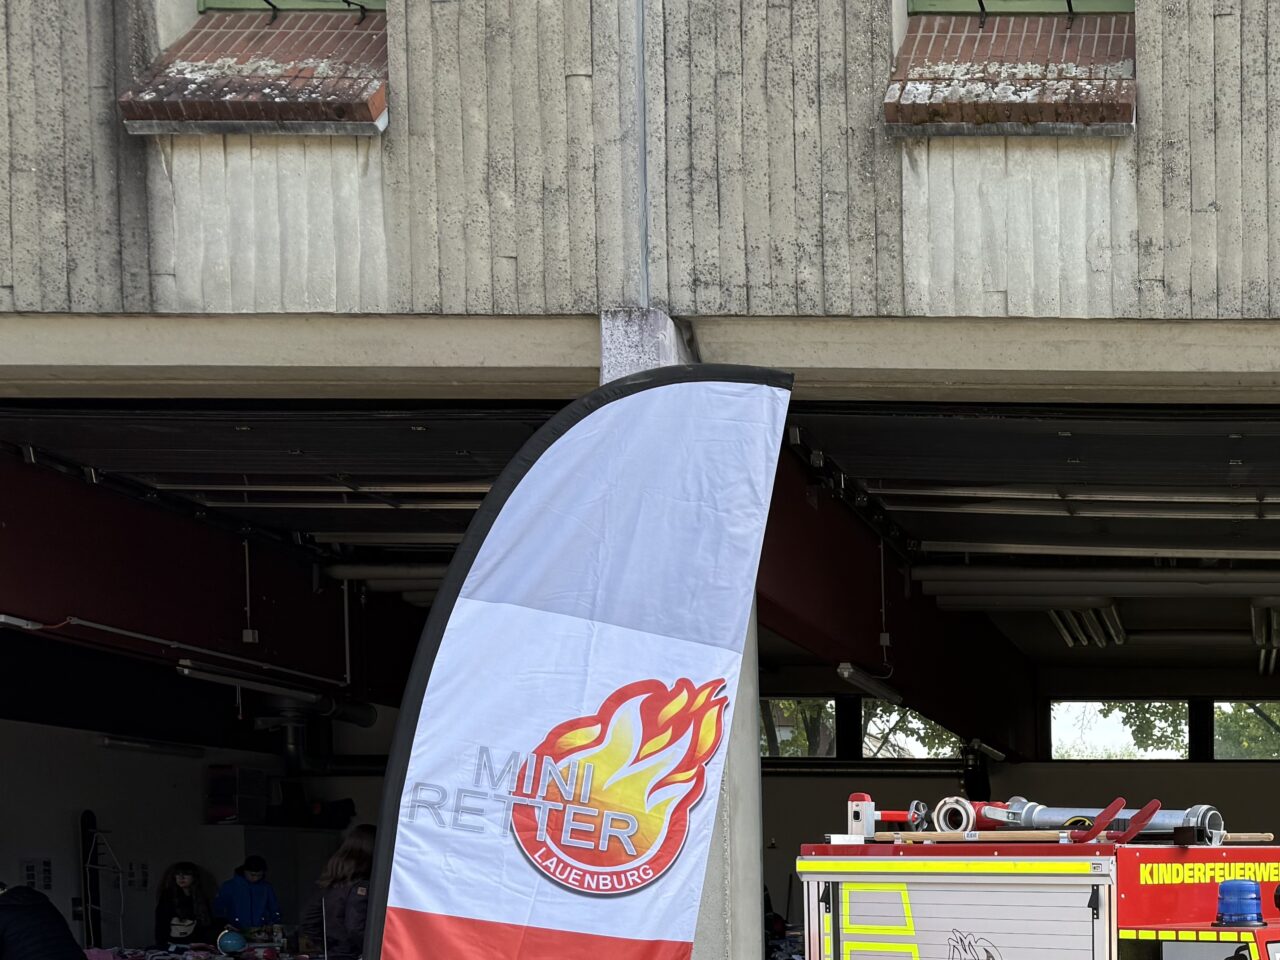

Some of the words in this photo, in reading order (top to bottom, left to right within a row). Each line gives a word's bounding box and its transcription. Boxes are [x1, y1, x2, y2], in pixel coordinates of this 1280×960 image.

[472, 745, 594, 804] MINI
[406, 781, 639, 856] RETTER
[532, 846, 655, 890] LAUENBURG
